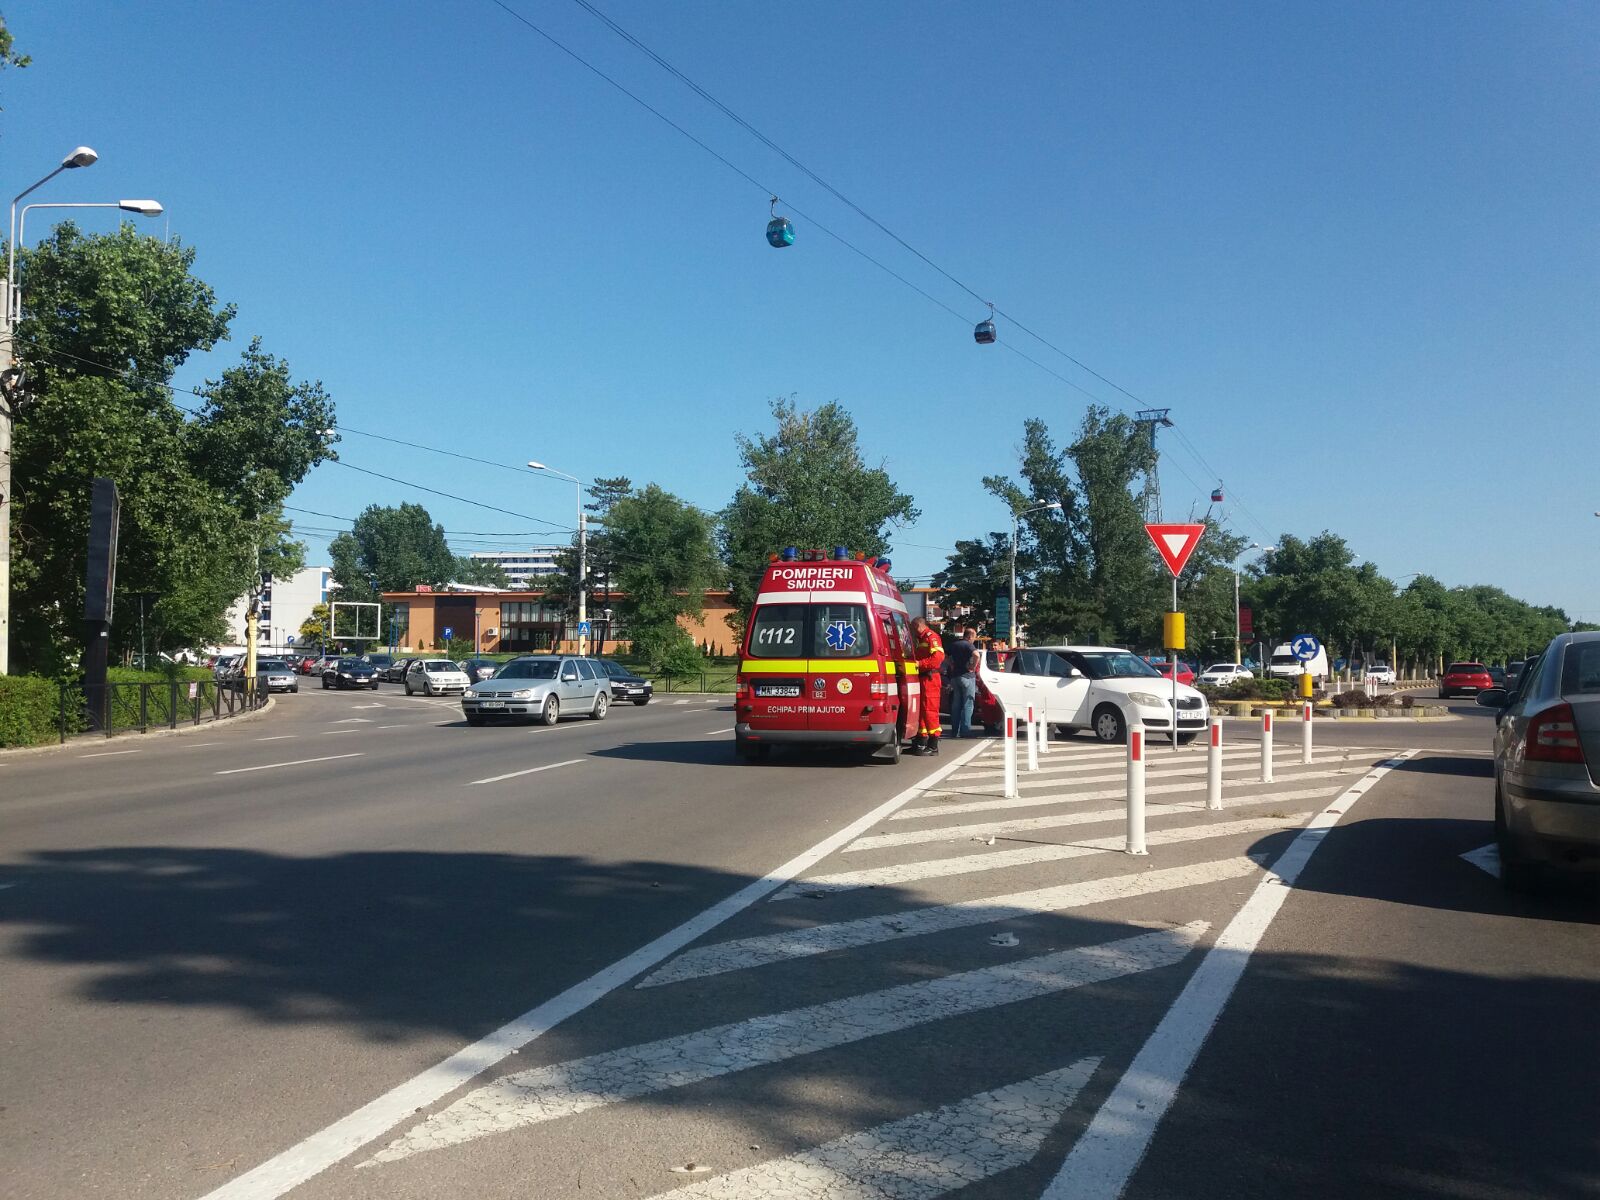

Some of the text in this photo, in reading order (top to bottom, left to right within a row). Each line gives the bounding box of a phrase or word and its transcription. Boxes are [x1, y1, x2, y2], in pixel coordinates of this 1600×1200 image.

[772, 568, 853, 580] POMPIERII
[787, 579, 836, 589] SMURD
[766, 627, 795, 644] 112
[761, 686, 797, 695] MAI 33844
